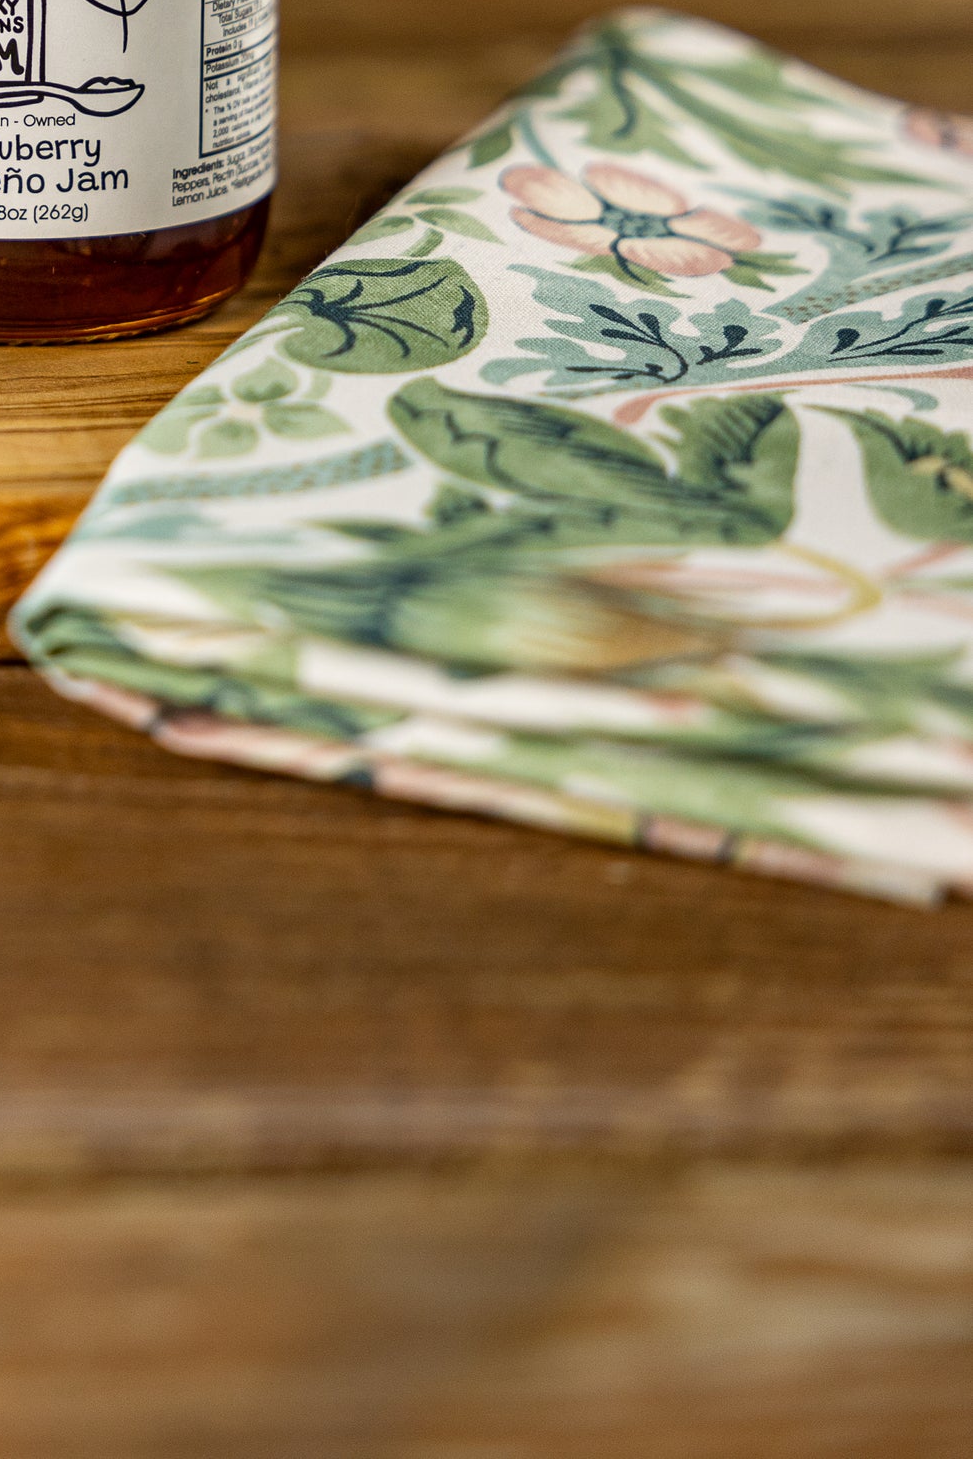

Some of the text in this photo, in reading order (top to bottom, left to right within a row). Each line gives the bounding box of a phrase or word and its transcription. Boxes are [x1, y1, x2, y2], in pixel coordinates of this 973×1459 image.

[206, 43, 232, 57] Protein
[23, 113, 76, 128] Owned
[172, 158, 225, 180] Ingredients:
[56, 168, 129, 192] Jam
[172, 191, 205, 207] Lemon
[33, 202, 89, 223] (262g)
